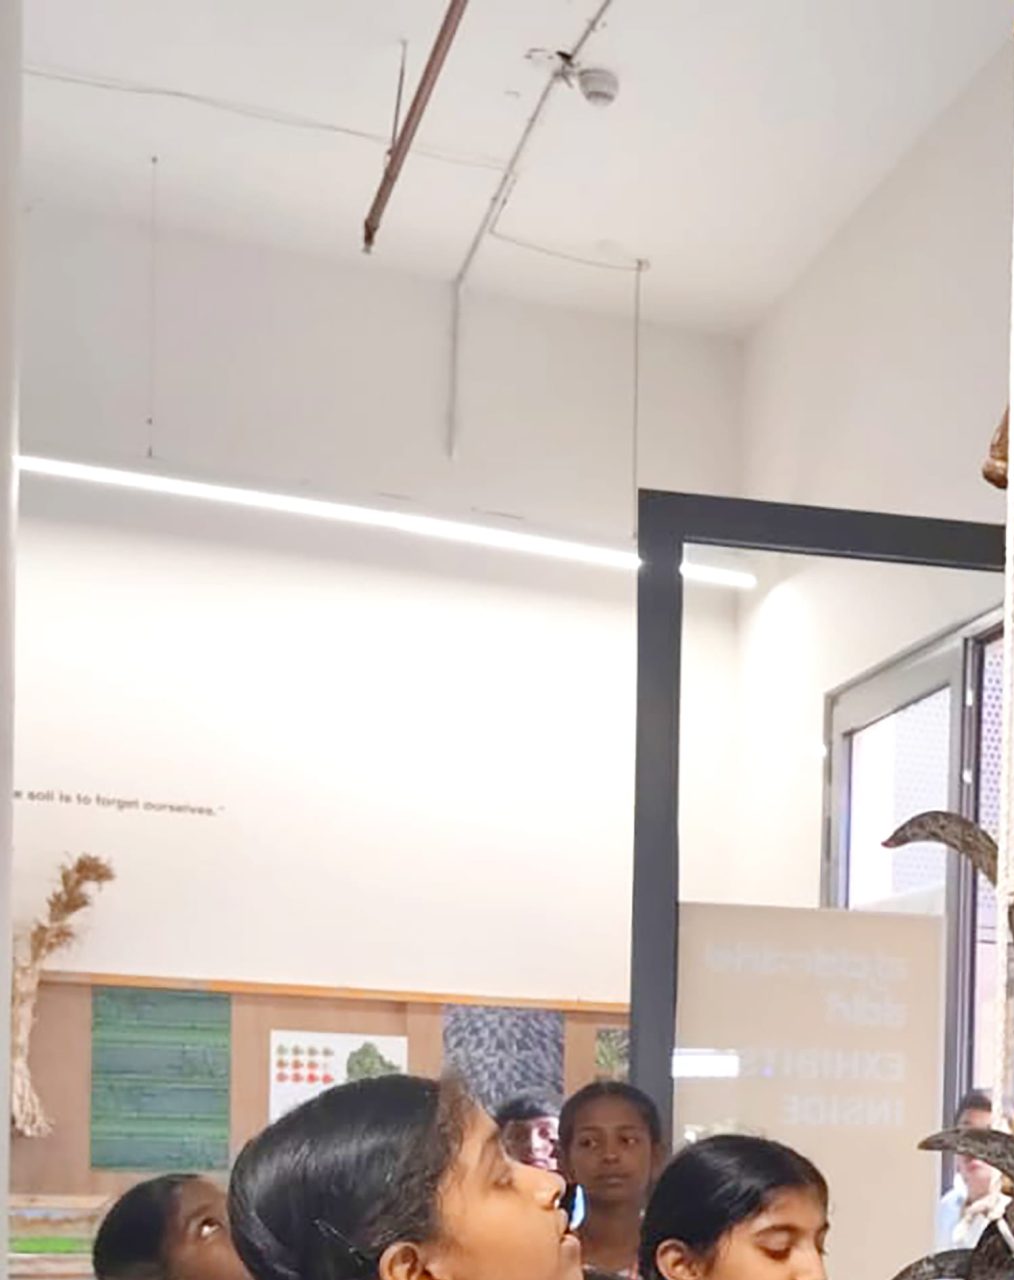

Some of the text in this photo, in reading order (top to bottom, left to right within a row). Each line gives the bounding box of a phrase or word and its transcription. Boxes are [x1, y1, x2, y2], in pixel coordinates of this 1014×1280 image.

[27, 789, 54, 802] soil
[60, 791, 72, 803] is
[77, 793, 92, 806] to
[96, 794, 139, 812] forget
